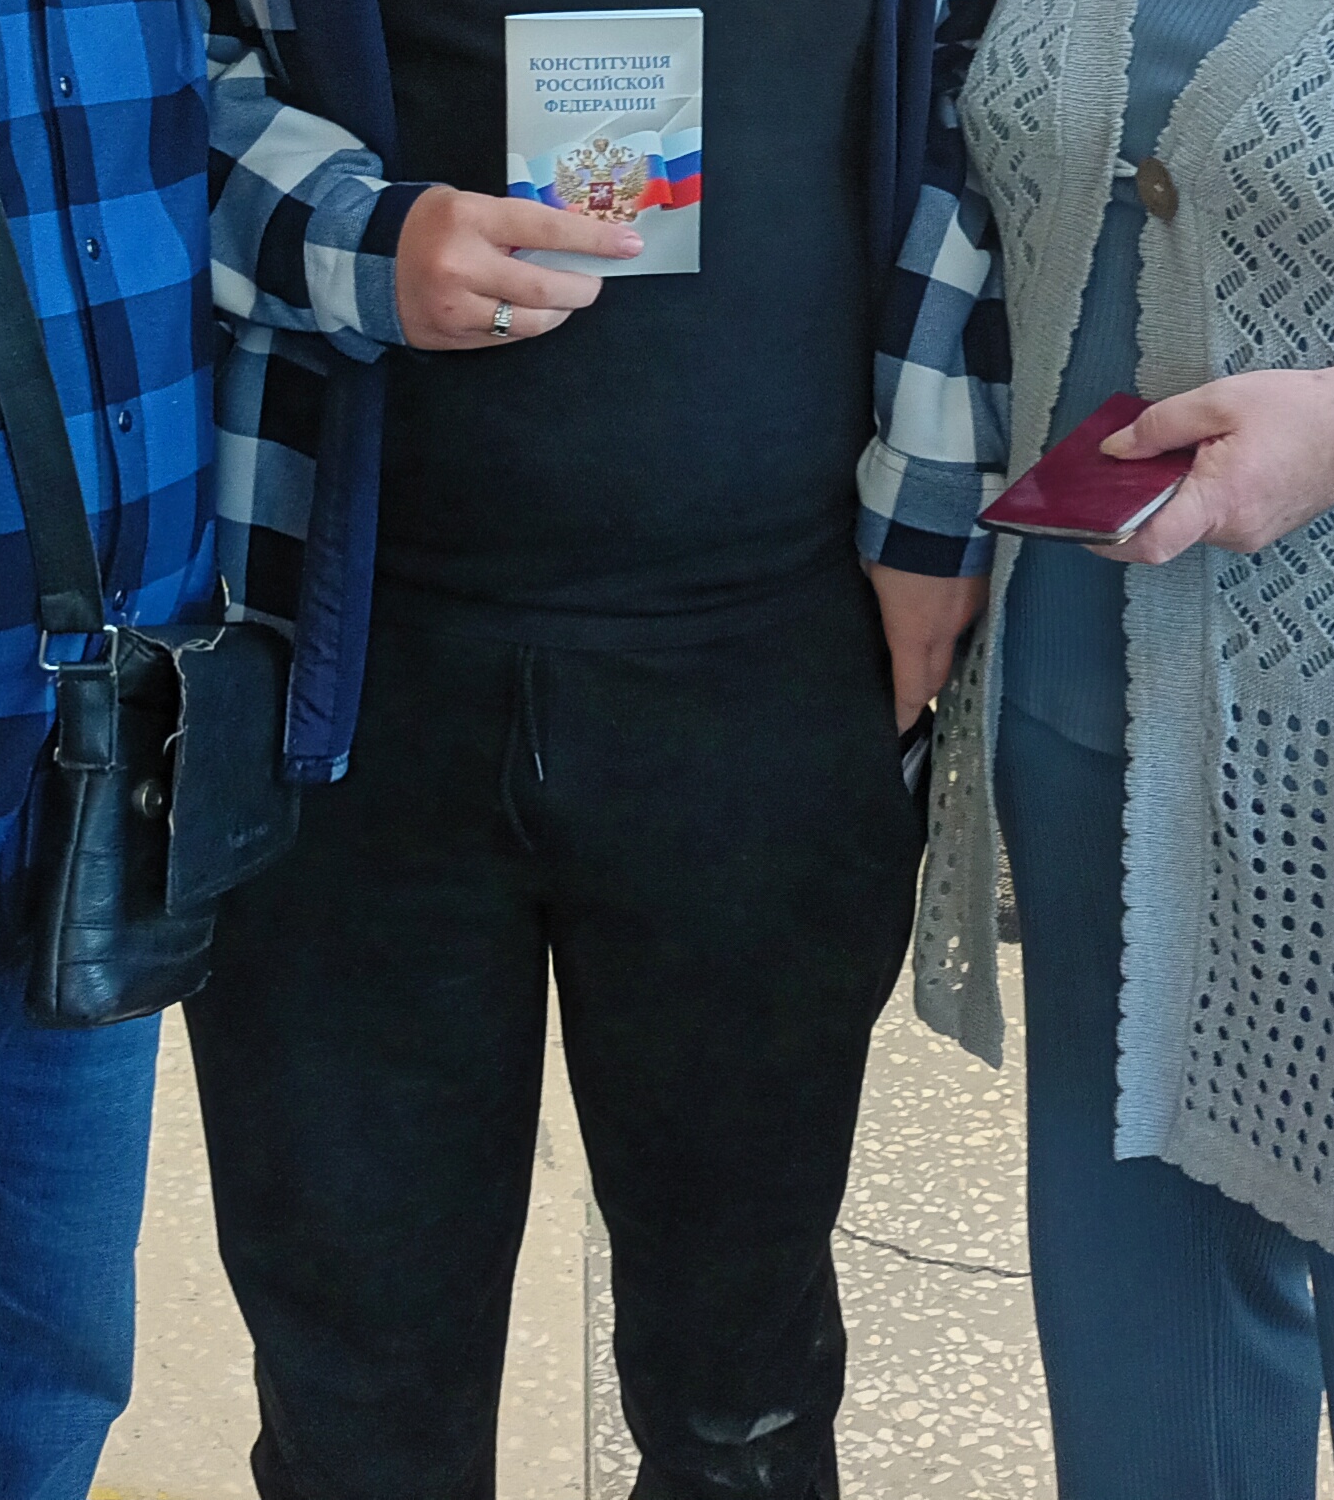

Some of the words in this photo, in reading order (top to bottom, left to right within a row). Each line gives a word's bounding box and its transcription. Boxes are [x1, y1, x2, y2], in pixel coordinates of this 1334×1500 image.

[528, 55, 671, 71] КОНСТИТУЦИЯ
[534, 74, 665, 92] РОССИЙСКОЙ
[544, 97, 656, 113] ФЕДЕРАЦИИ
